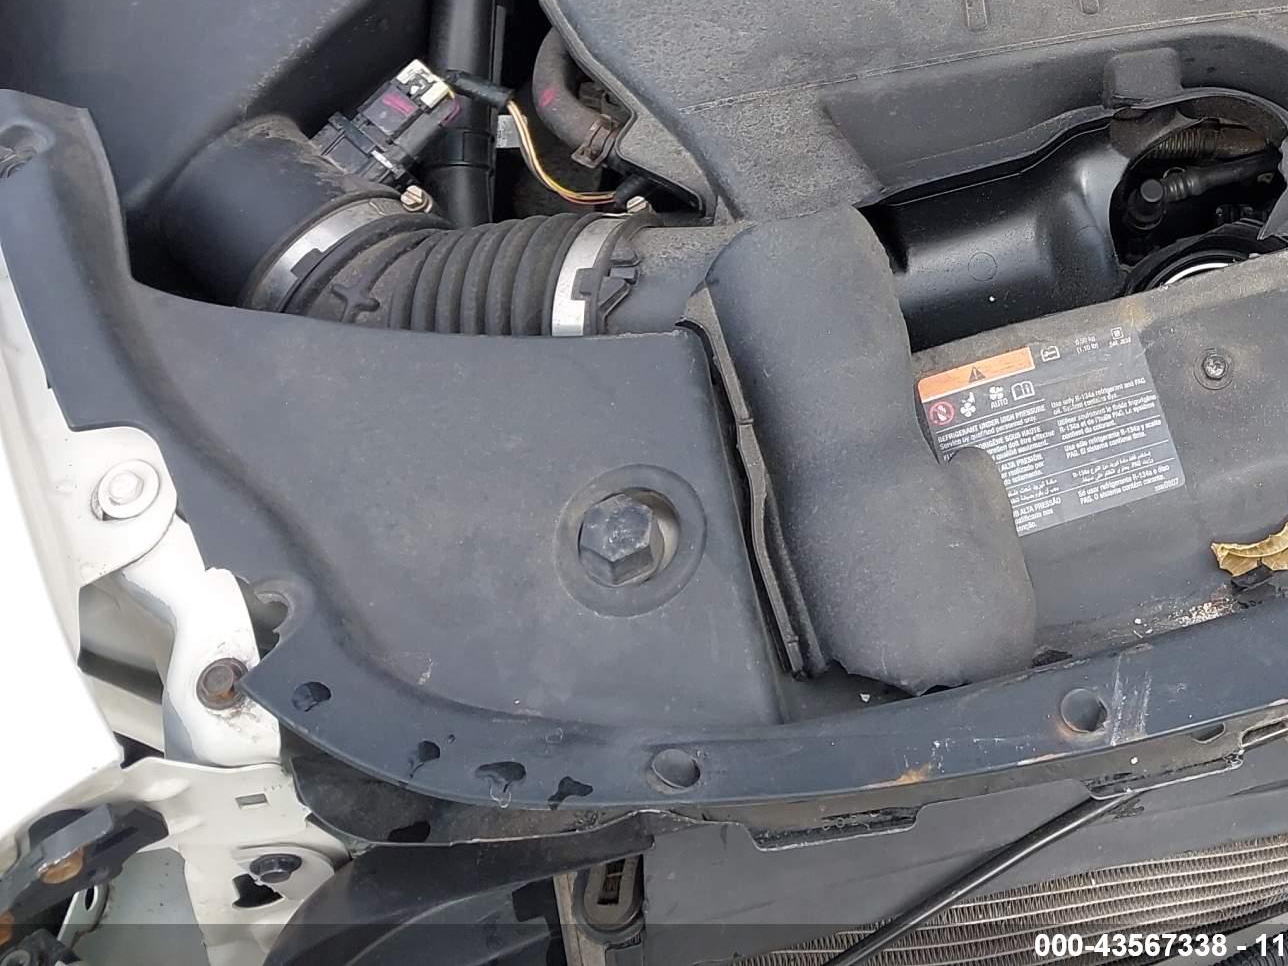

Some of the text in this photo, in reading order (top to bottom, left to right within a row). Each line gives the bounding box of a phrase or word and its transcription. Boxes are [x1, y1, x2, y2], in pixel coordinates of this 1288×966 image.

[991, 398, 1008, 409] AUTO
[938, 405, 1045, 442] REFRIGERANT UNDER HIGH PRESSURE
[1001, 461, 1015, 470] ALTA
[1020, 506, 1033, 515] ALTA
